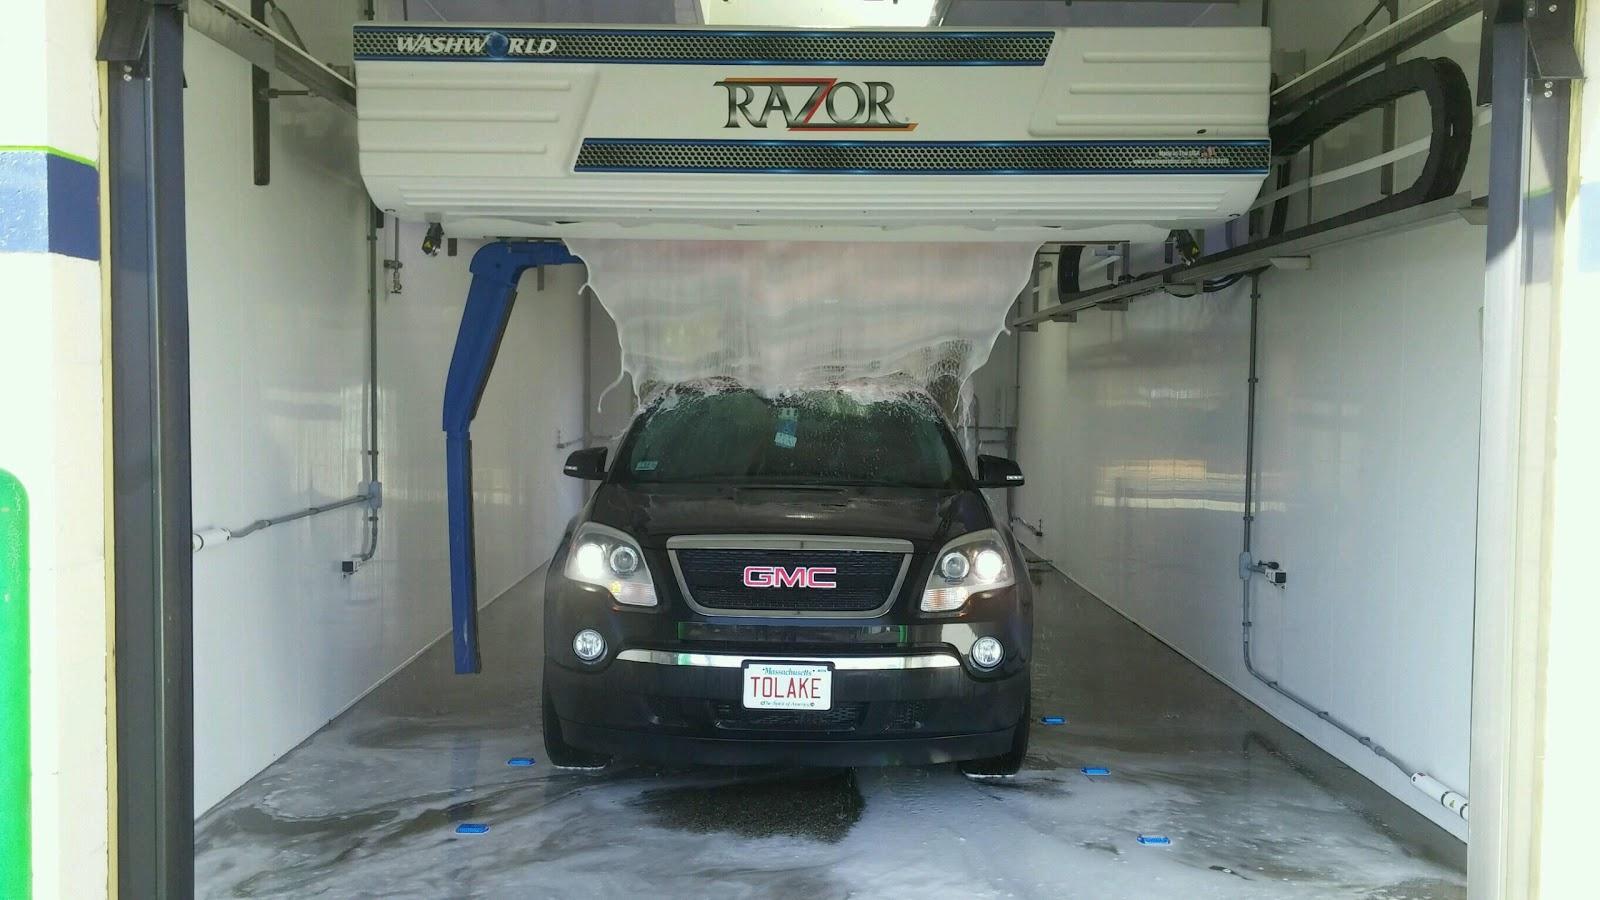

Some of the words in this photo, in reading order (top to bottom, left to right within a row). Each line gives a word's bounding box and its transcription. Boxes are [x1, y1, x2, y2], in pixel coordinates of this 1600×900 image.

[713, 78, 918, 131] RAZOR
[744, 566, 837, 588] GMC
[765, 667, 812, 676] Massachusetts
[750, 677, 821, 698] TOLAKE
